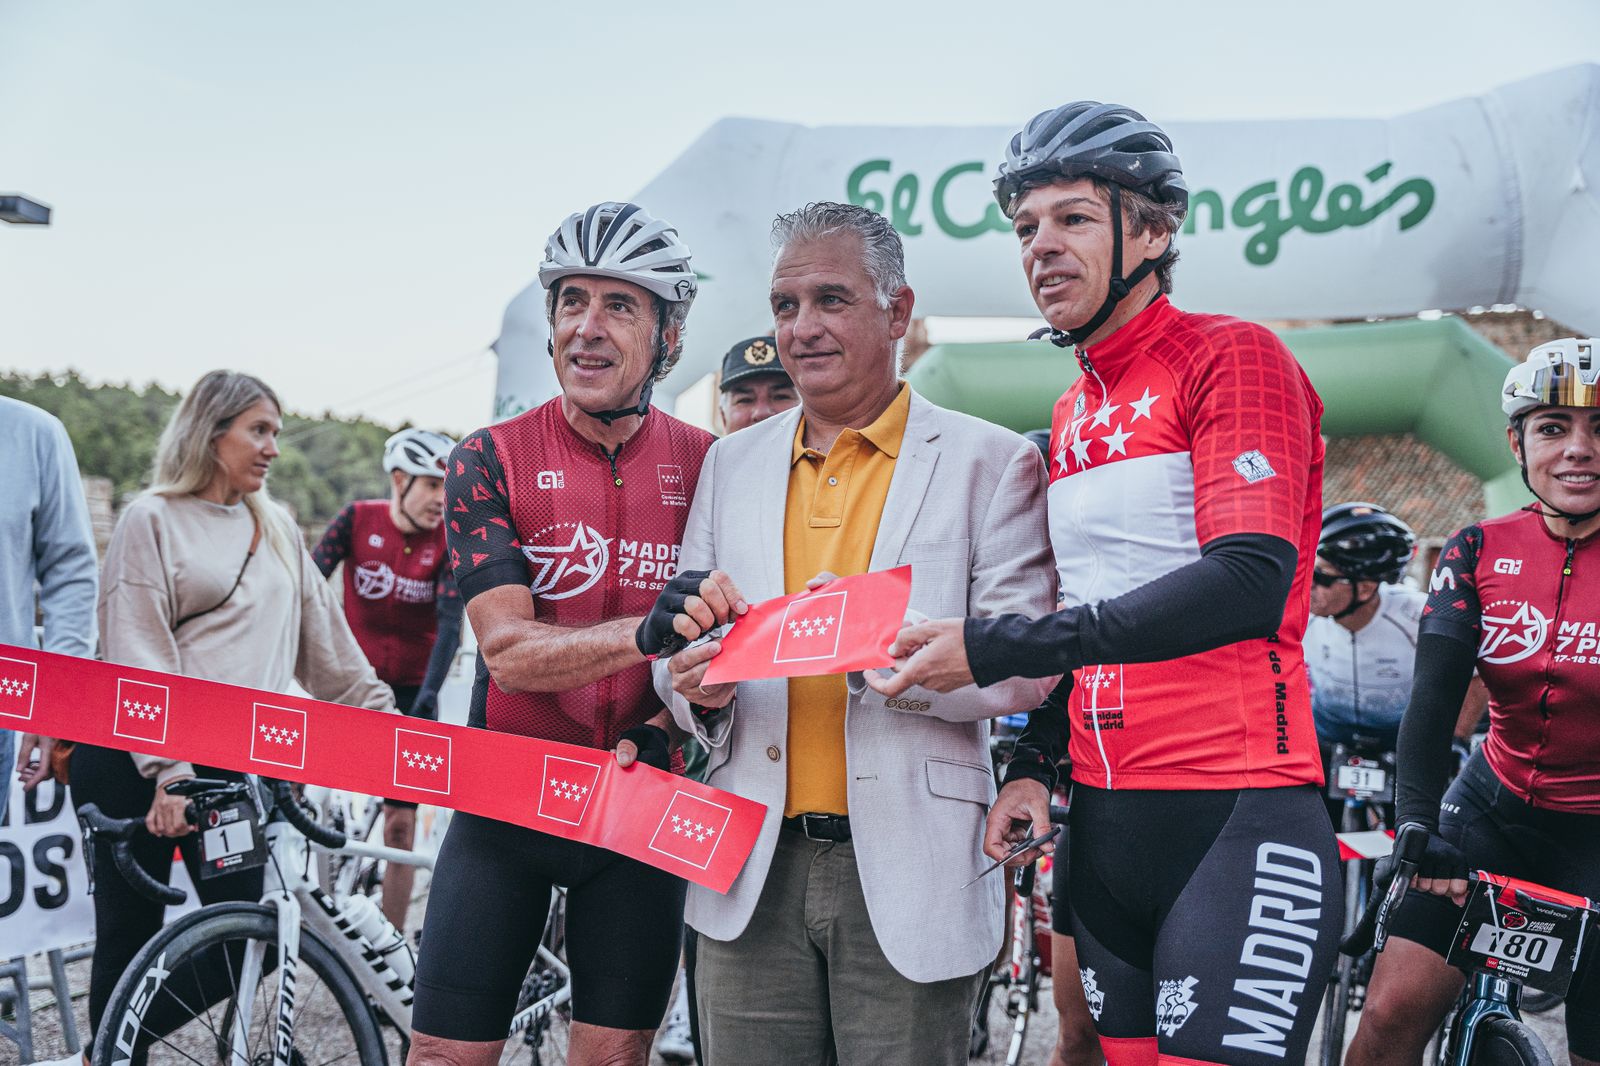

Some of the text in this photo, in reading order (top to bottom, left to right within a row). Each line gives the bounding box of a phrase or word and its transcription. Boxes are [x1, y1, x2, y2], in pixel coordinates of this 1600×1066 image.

[1183, 161, 1435, 266] nglés
[619, 538, 681, 561] MADR
[618, 557, 676, 581] 7 PIC
[619, 578, 667, 590] 17-18 SE
[1556, 636, 1574, 652] 7
[1554, 654, 1587, 664] 17-18
[1268, 650, 1281, 674] de
[1275, 682, 1289, 755] Madrid
[220, 829, 230, 853] 1
[1536, 907, 1568, 919] wahoo
[1221, 842, 1322, 1058] MADRID
[1487, 932, 1548, 965] 180
[1498, 960, 1530, 972] Comunidad
[1506, 967, 1528, 978] Madrid
